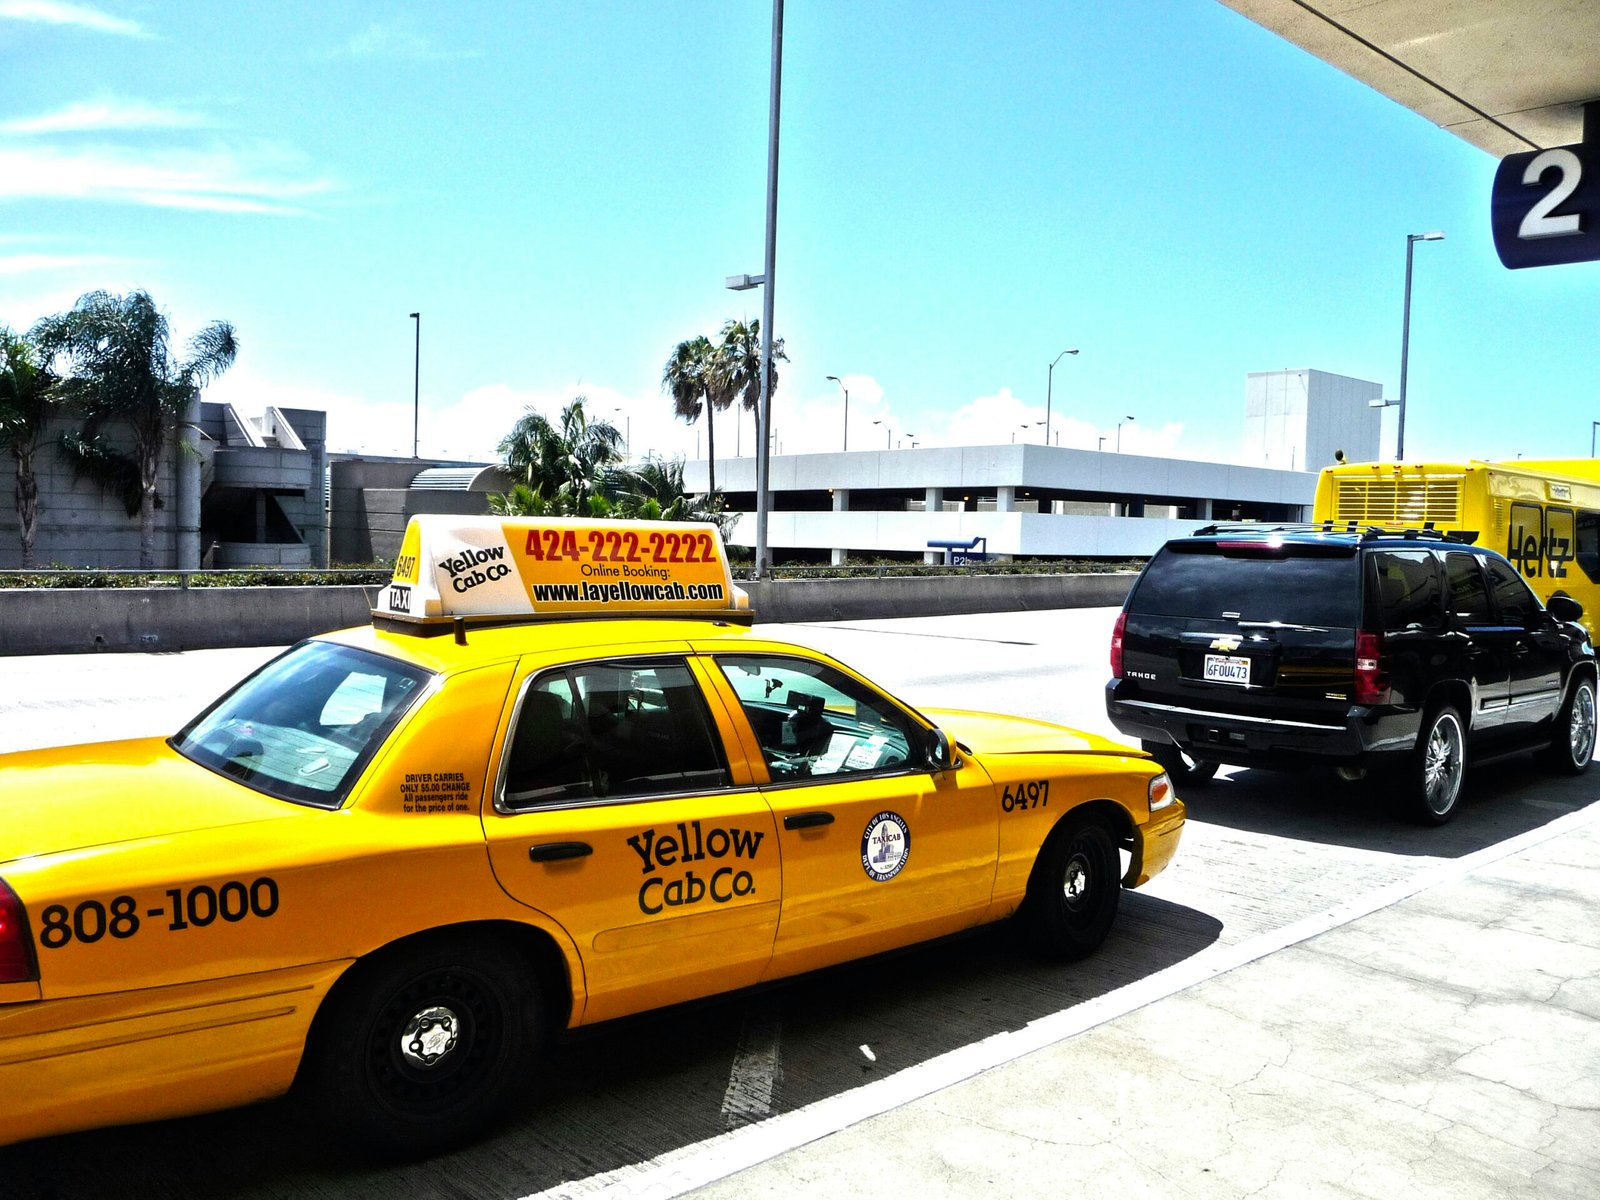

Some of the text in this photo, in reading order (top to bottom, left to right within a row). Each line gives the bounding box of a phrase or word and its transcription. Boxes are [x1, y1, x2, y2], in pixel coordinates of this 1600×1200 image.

[1518, 149, 1583, 239] 2
[525, 529, 717, 563] 424-222-2222
[1506, 524, 1569, 578] Hertz
[396, 555, 416, 579] 6497
[438, 546, 505, 578] Yellow
[580, 564, 671, 580] Online Booking:
[452, 563, 512, 593] Cab Co.
[390, 588, 411, 610] TAXI
[532, 580, 724, 602] www.layellowcab.com
[1126, 670, 1157, 681] TAHOE
[400, 782, 471, 793] ONLY $5.00 CHANGE
[405, 772, 464, 783] DRIVER CARRIES
[403, 802, 470, 813] for the price of one.
[404, 792, 468, 803] All passengers ride
[1001, 780, 1050, 814] 6497
[627, 820, 765, 874] Yellow
[871, 833, 902, 845] TAXICAB
[638, 866, 757, 915] Cab Co.
[39, 876, 280, 949] 808-1000
